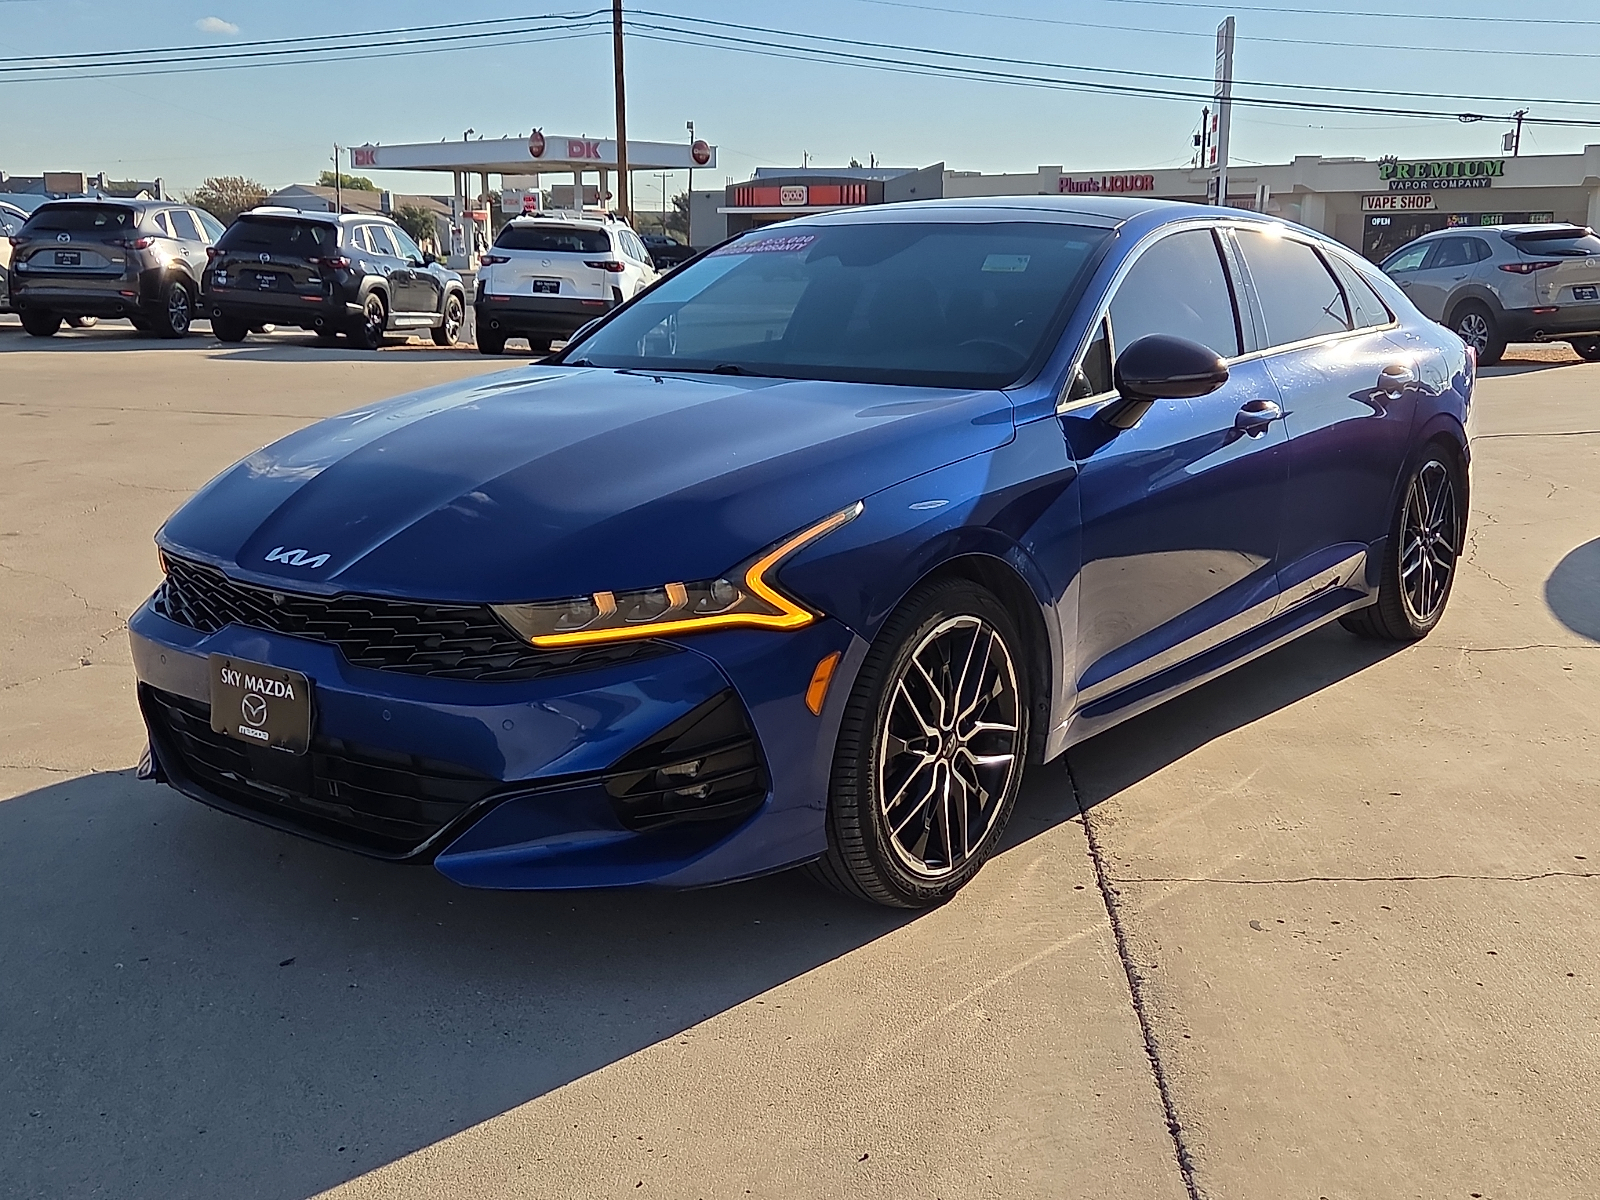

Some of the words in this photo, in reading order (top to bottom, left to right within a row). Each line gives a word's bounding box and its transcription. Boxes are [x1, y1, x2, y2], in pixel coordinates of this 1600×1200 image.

[354, 149, 377, 166] DK
[567, 140, 602, 159] DK
[1379, 160, 1505, 180] PREMIUM
[1059, 177, 1100, 193] Plum's
[1101, 175, 1155, 192] LIQUOR
[1391, 181, 1428, 190] VAPOR
[1433, 179, 1488, 189] COMPANY
[1367, 196, 1397, 209] VAPE
[1400, 195, 1432, 209] SHOP
[264, 545, 332, 569] KIA
[221, 668, 242, 688] SKY
[244, 674, 295, 701] MAZDA
[238, 725, 269, 741] mazda
